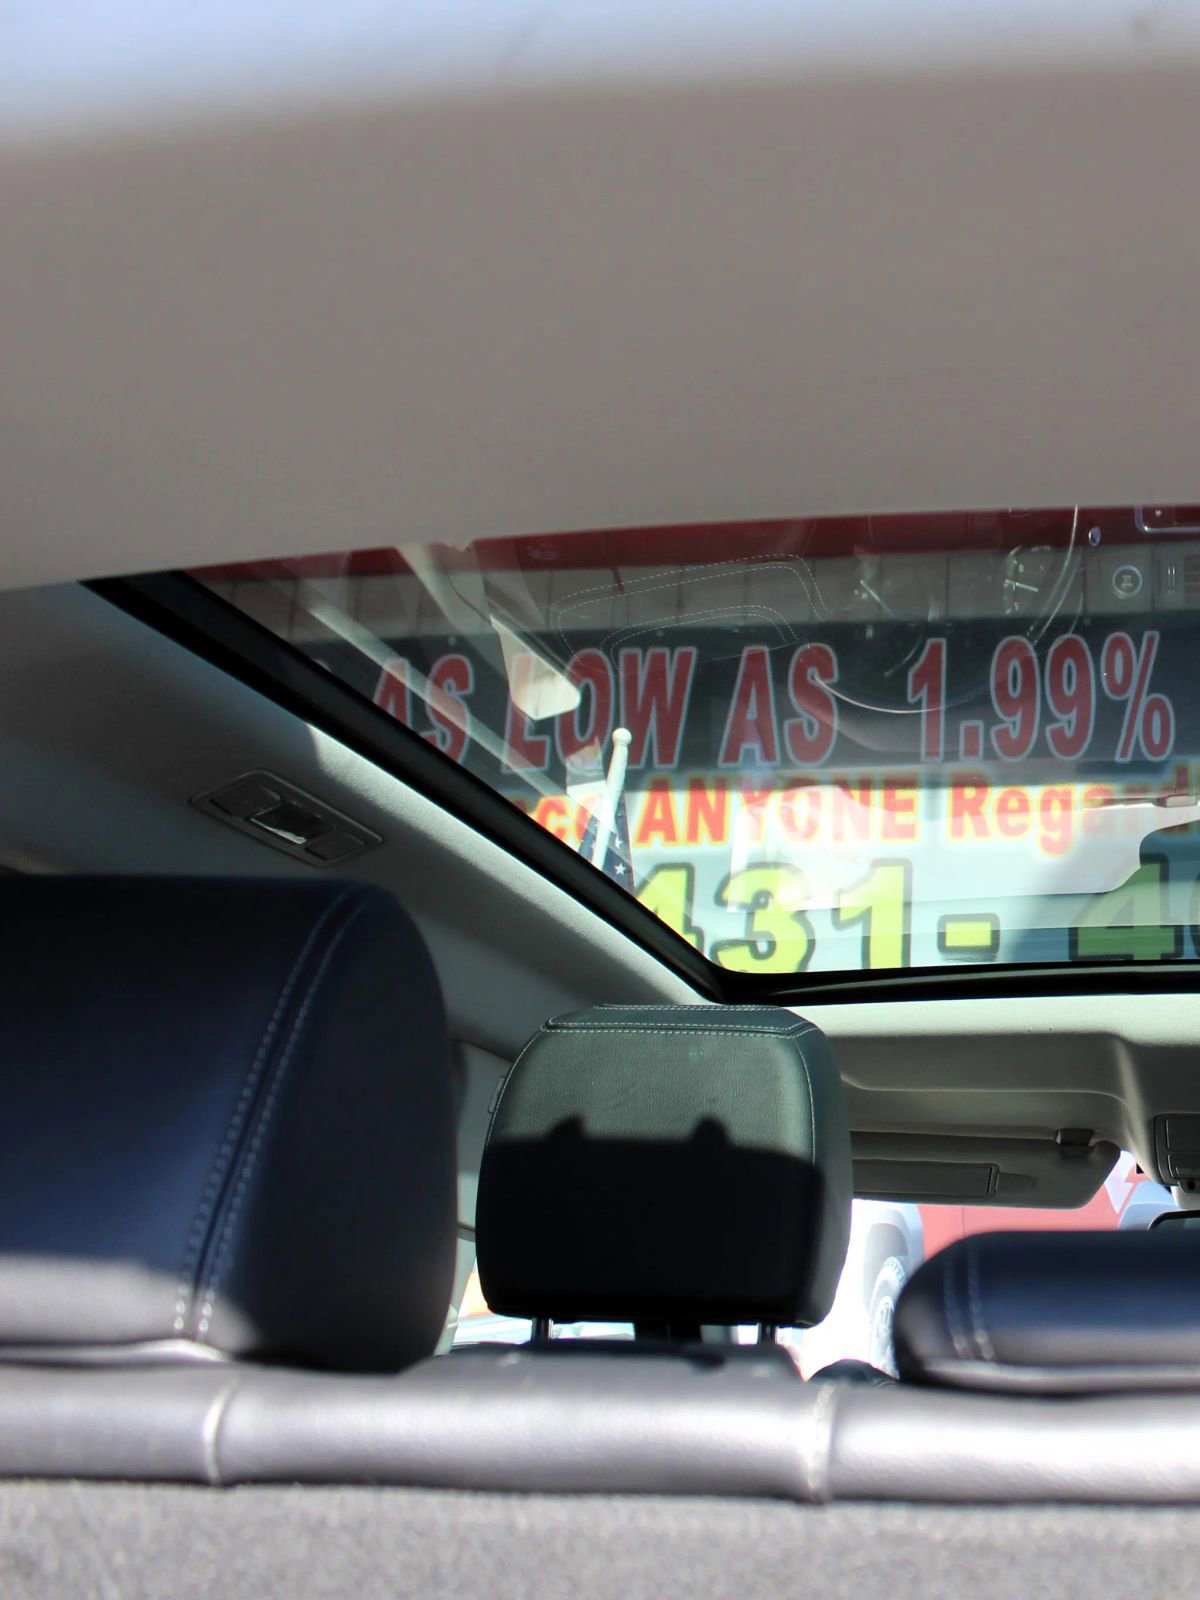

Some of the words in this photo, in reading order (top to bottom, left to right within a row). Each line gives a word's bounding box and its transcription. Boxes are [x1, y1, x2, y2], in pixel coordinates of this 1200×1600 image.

[372, 654, 475, 766] AS
[502, 646, 698, 773] LOW
[718, 641, 840, 770] AS
[907, 629, 1175, 764] 1.99%
[634, 768, 920, 845] ANYONE
